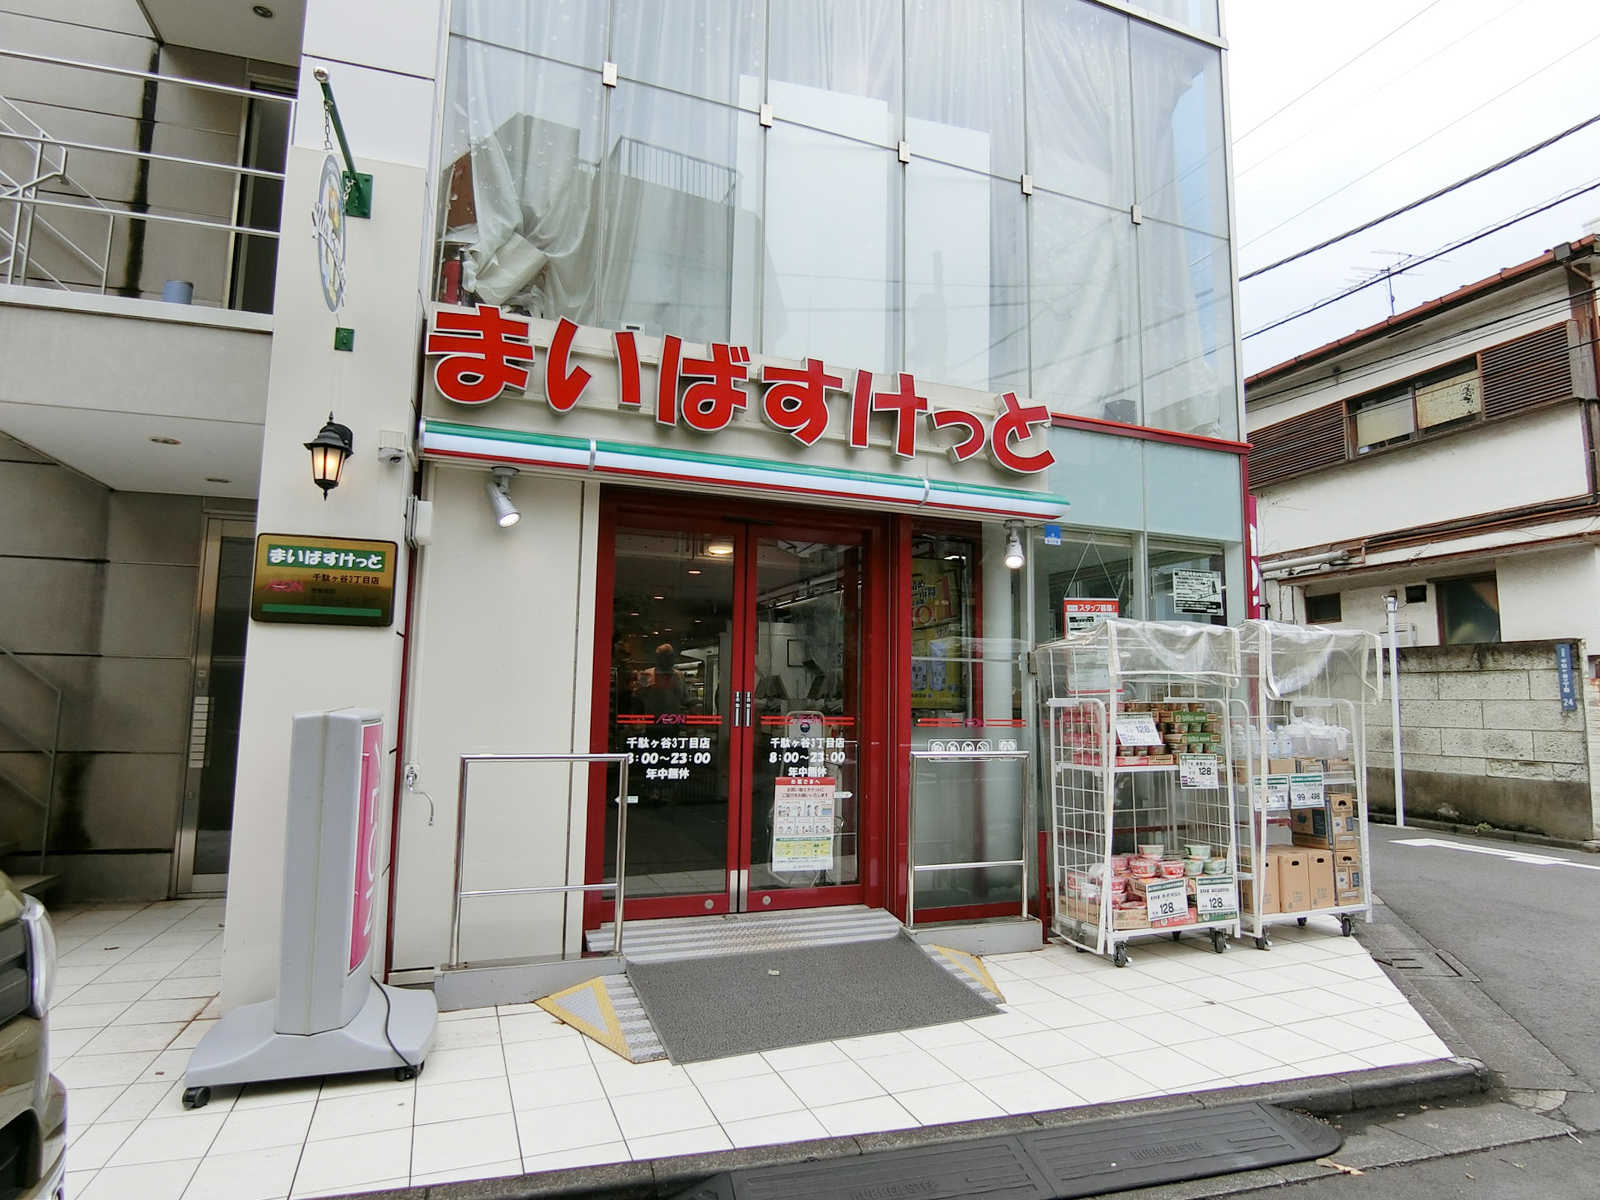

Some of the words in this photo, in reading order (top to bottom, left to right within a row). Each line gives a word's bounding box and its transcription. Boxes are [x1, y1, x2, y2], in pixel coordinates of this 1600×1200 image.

[425, 303, 1057, 475] まいばすけっと
[269, 547, 383, 569] まいばすけっと
[1562, 698, 1574, 706] 24
[1135, 725, 1150, 734] 128
[626, 737, 711, 749] 千駄ヶ谷3丁目店
[770, 737, 845, 749] 千駄ヶ谷3丁目店
[646, 768, 690, 780] 年中無休
[788, 766, 827, 777] 年中無休
[1198, 767, 1212, 776] 128
[1296, 793, 1306, 801] 99
[1160, 902, 1174, 914] 128
[1209, 897, 1223, 909] 128
